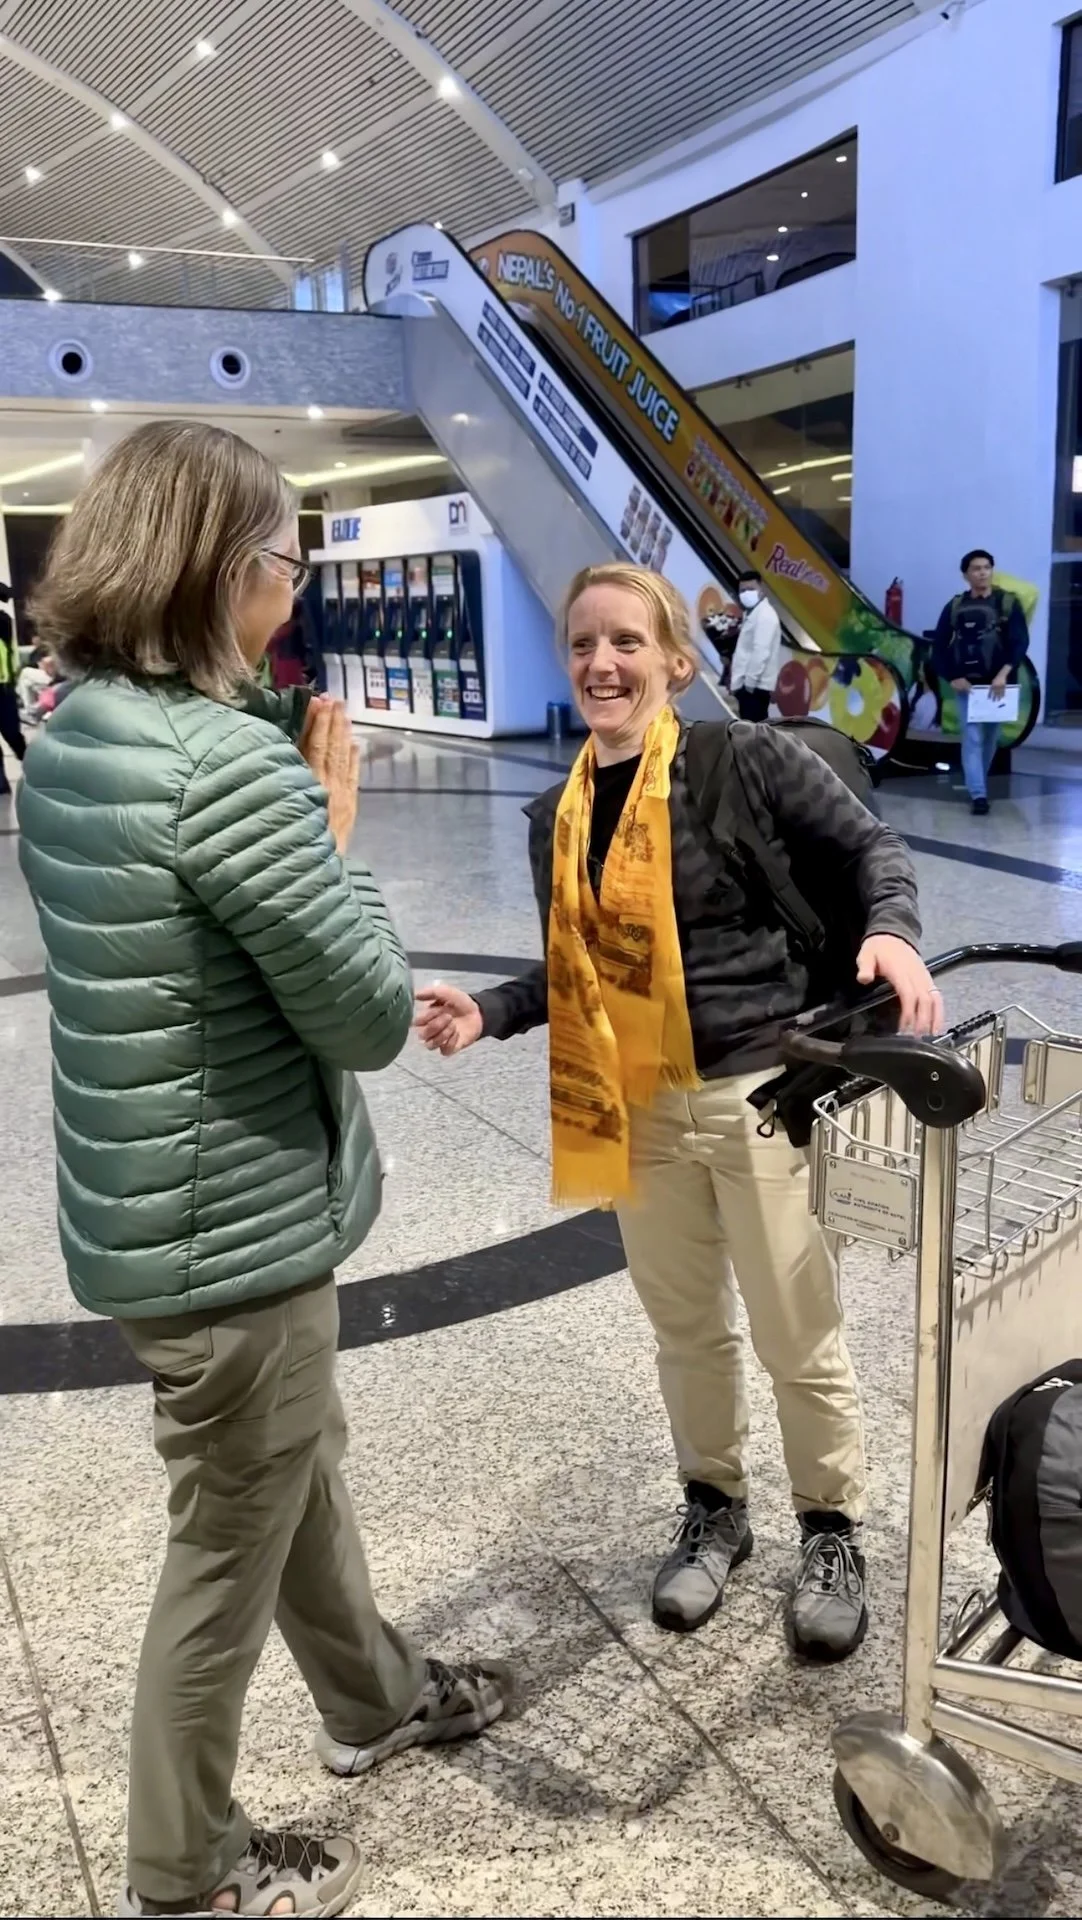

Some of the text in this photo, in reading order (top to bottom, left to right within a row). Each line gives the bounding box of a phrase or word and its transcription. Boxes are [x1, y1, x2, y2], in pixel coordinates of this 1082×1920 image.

[497, 251, 555, 291] NEPAL'S
[583, 319, 630, 379] FRUIT
[627, 368, 679, 443] JUICE
[765, 544, 805, 579] Real
